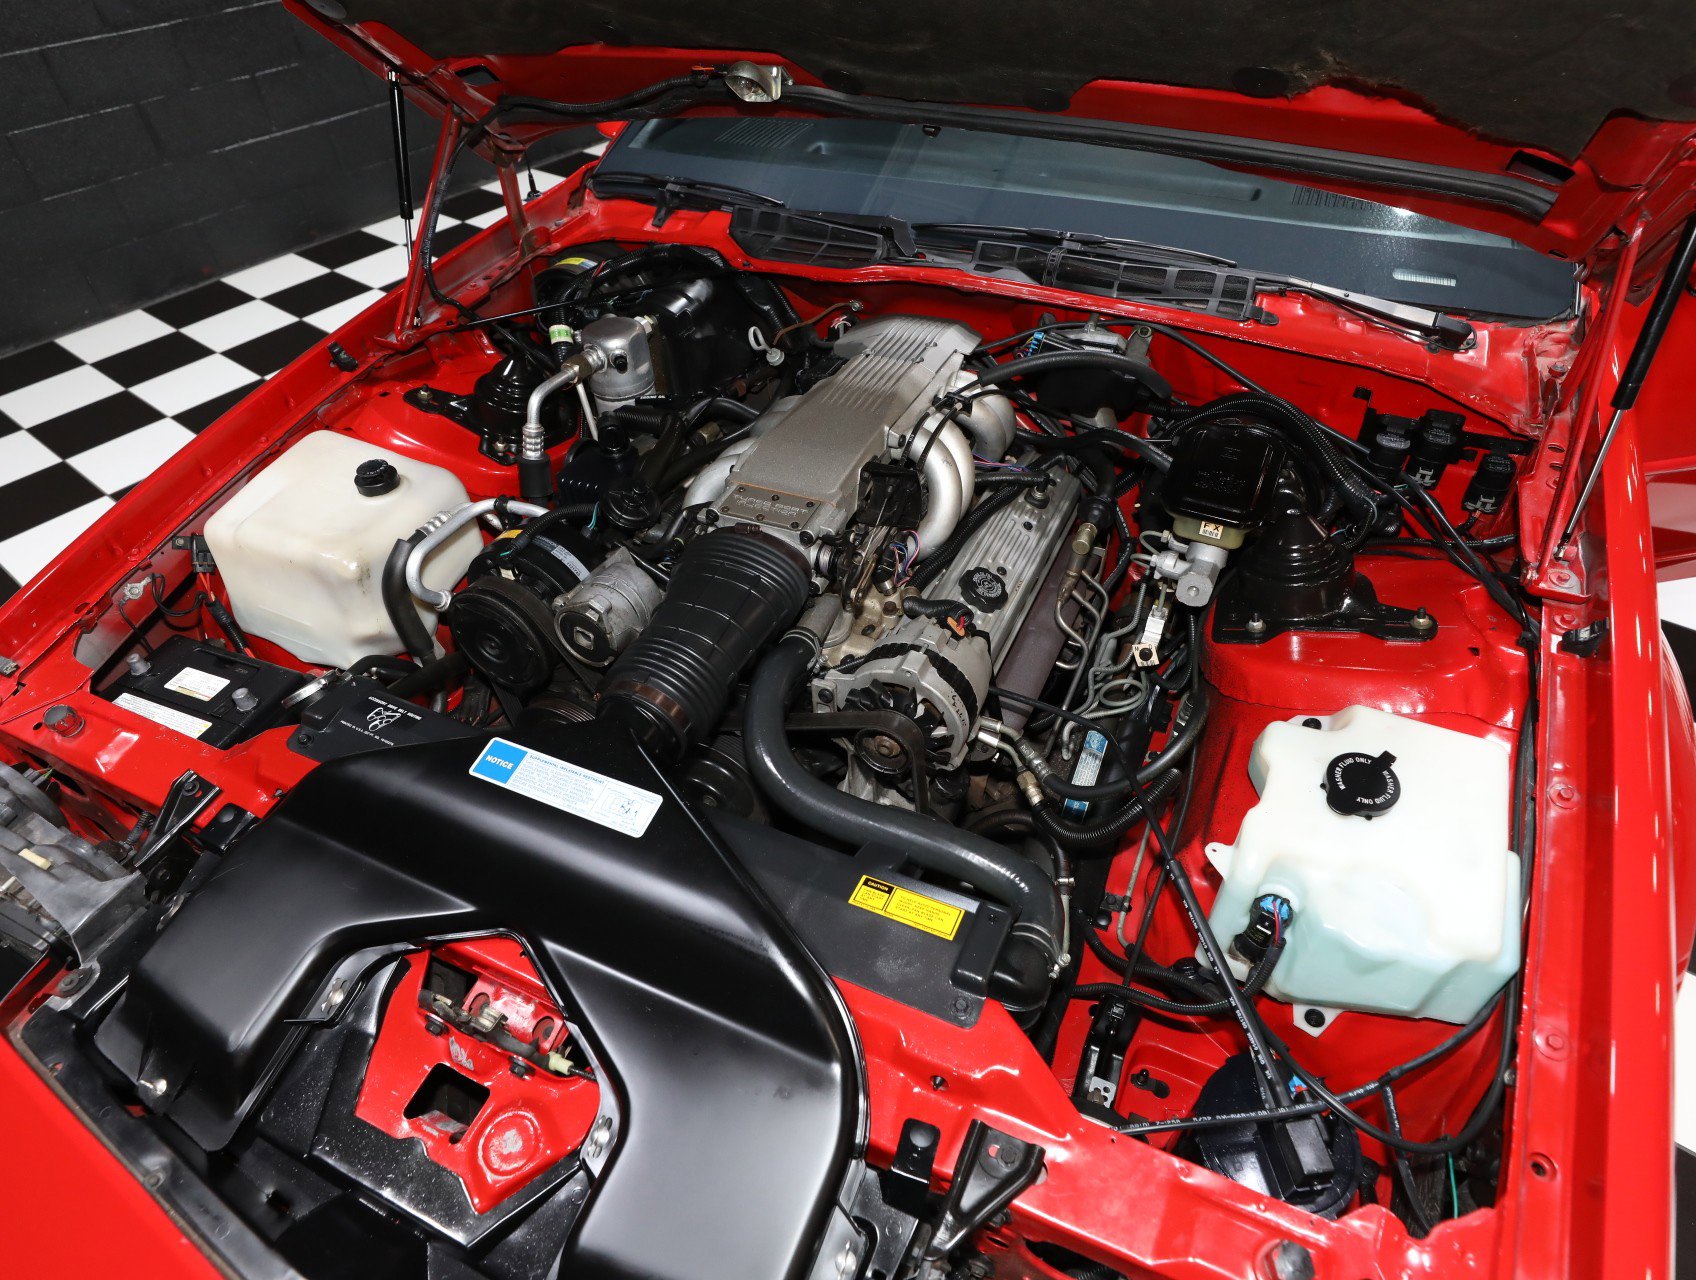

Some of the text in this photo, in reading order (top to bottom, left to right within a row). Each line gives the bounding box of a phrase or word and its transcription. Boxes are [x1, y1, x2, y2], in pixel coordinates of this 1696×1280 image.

[485, 754, 514, 769] NOTICE
[1339, 758, 1354, 767] FLUID
[1334, 767, 1346, 790] WASHER
[1357, 770, 1394, 804] WASHER FLUID ONLY
[868, 881, 889, 891] CAUTION
